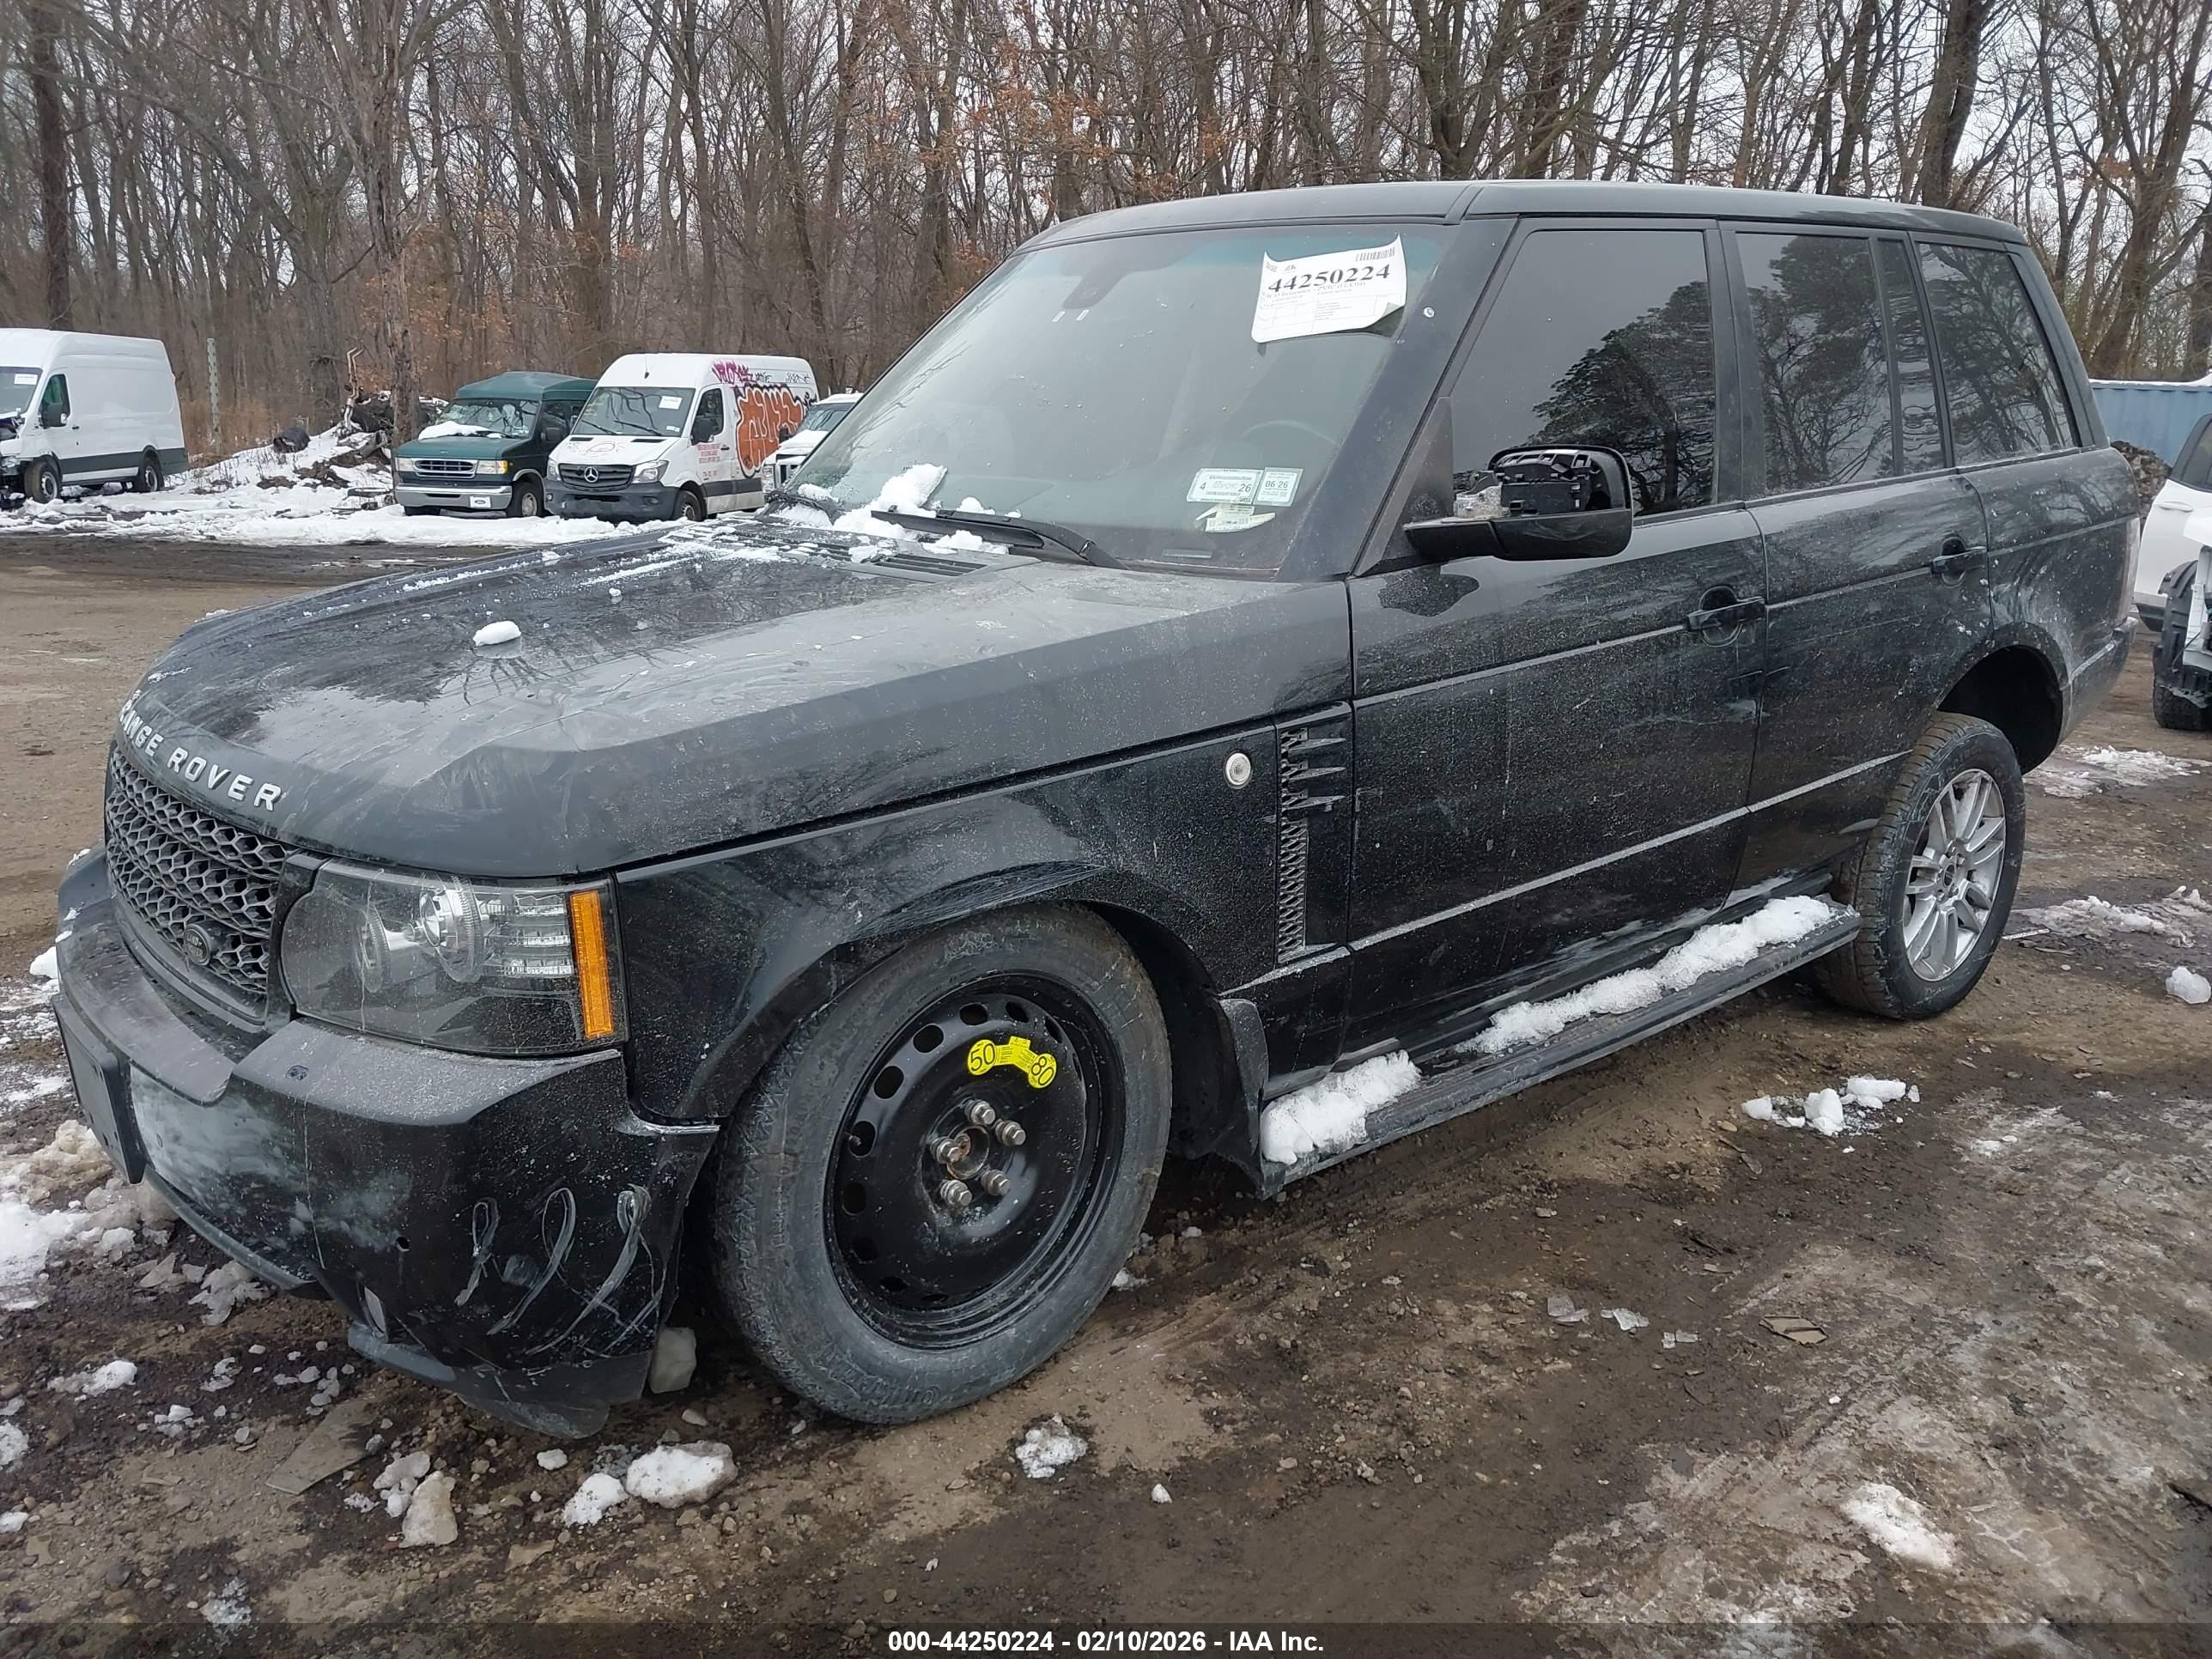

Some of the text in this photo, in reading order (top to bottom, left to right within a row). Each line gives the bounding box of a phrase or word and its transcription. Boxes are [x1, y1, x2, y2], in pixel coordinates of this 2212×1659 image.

[1268, 264, 1390, 293] 44250224
[1238, 483, 1252, 493] 26
[167, 747, 282, 811] ROVER
[970, 1043, 996, 1072] 50
[1030, 1055, 1054, 1086] 80
